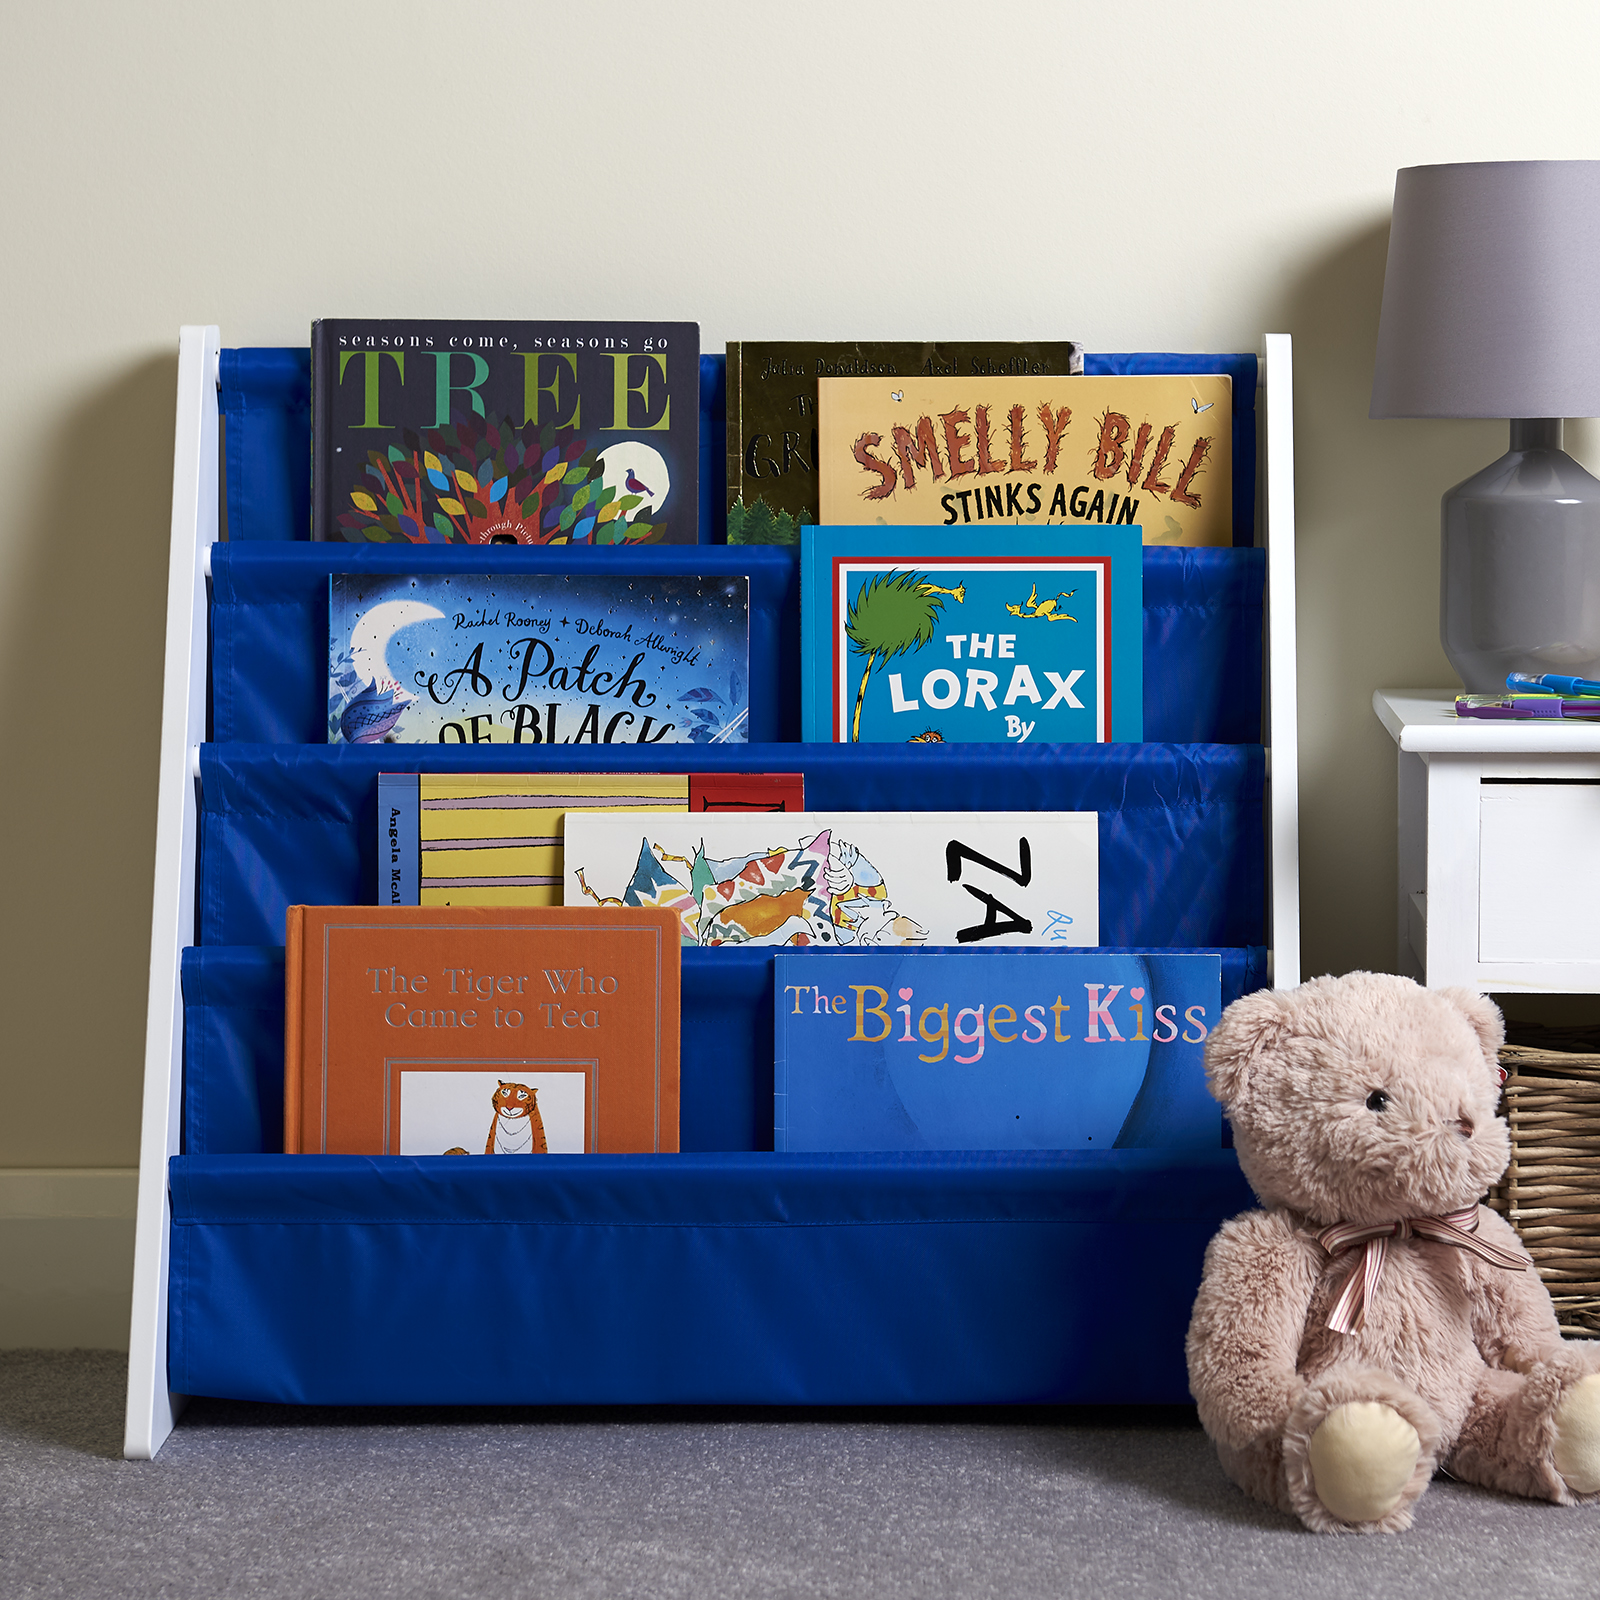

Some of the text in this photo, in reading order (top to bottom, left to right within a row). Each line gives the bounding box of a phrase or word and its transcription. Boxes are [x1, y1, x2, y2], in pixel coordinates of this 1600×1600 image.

[338, 335, 669, 352] seasons come, seasons go
[339, 351, 671, 431] TREE
[760, 356, 1051, 380] Julia Donaldson Axel Scheffler
[849, 401, 1217, 508] SMELLY BILL
[940, 482, 1140, 526] STINKS AGAIN
[452, 609, 699, 667] Rachel Rooney Deborah Allwright
[945, 632, 1017, 660] THE
[414, 637, 657, 709] A Patch
[888, 664, 1086, 713] LORAX
[500, 703, 676, 743] BLACK
[1004, 715, 1036, 743] By
[388, 807, 401, 906] Angela McAl
[945, 836, 1033, 944] ZA
[366, 966, 619, 1001] The Tiger Who
[383, 1002, 601, 1029] Came to Tea
[784, 983, 1209, 1065] The Biggest Kiss
